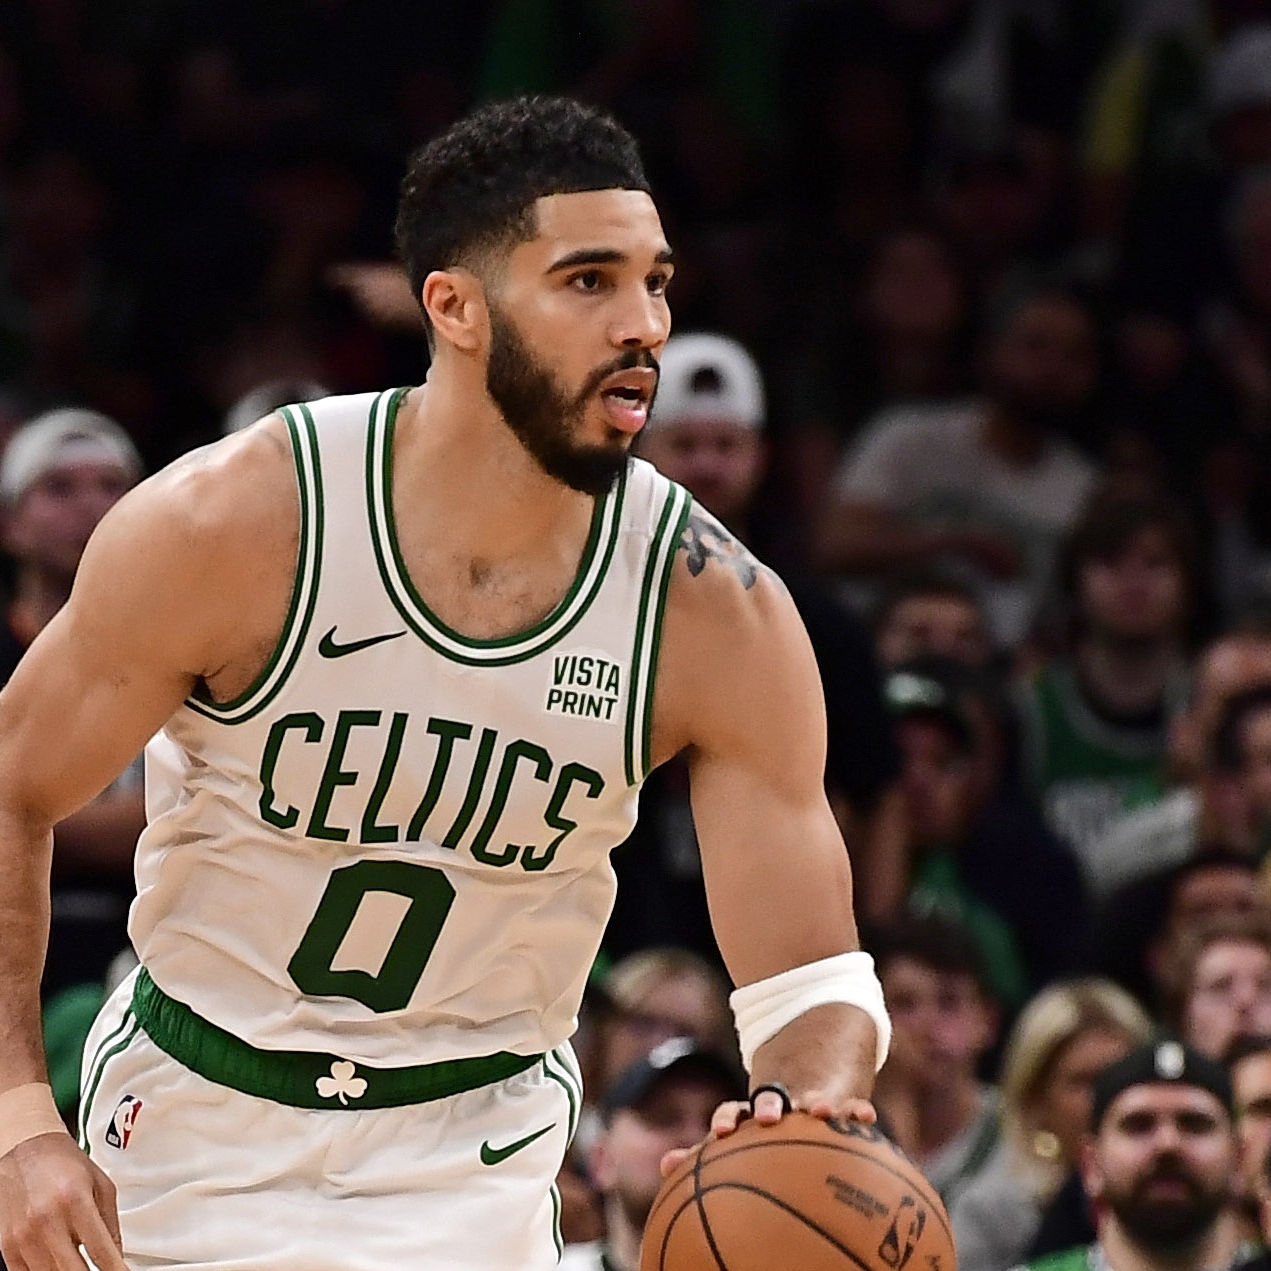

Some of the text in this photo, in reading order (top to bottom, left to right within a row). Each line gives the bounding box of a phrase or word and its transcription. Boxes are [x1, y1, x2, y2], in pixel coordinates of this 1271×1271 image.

[546, 688, 618, 720] PRINT
[554, 656, 620, 696] VISTA
[259, 710, 605, 871] CELTICS
[287, 860, 456, 1013] 0
